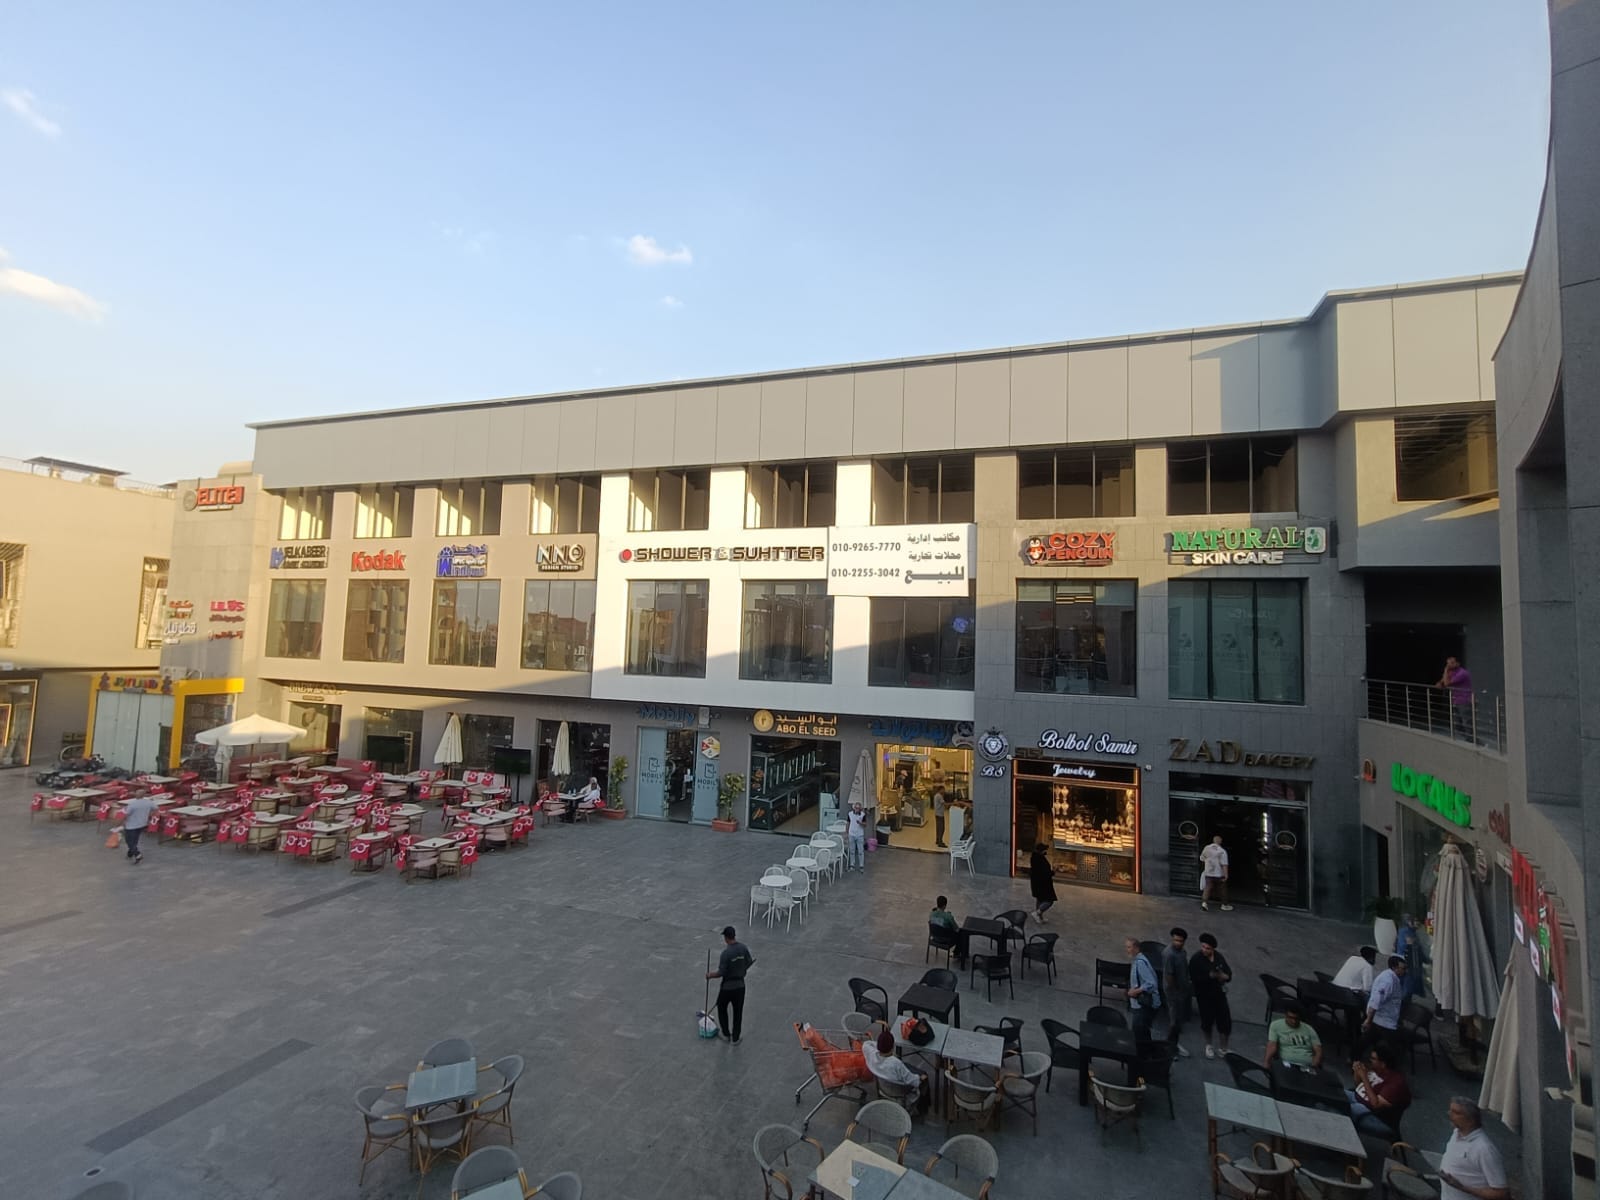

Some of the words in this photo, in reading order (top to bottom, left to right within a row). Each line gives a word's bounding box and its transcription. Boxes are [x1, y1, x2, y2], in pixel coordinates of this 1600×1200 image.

[933, 533, 960, 542] مكاتب
[1048, 532, 1116, 549] COZY
[1172, 527, 1304, 552] NATURAL
[635, 547, 712, 562] SHOWER
[731, 546, 825, 562] SUHTTER
[832, 542, 902, 552] 010-9265-7770
[1046, 548, 1114, 560] PENGUIN
[351, 549, 406, 572] Kodak
[1192, 552, 1231, 565] SKIN
[1233, 551, 1284, 564] CARE
[831, 568, 900, 577] 010-2255-3042
[776, 725, 797, 734] ABO
[798, 726, 811, 735] EL
[812, 727, 837, 736] SEED
[1038, 729, 1093, 753] Bolbol
[1094, 733, 1138, 755] Samir
[1169, 737, 1242, 764] ZAD
[1244, 752, 1316, 769] BAKERY
[1052, 763, 1096, 778] Jewelry
[1391, 762, 1472, 828] LOCALS
